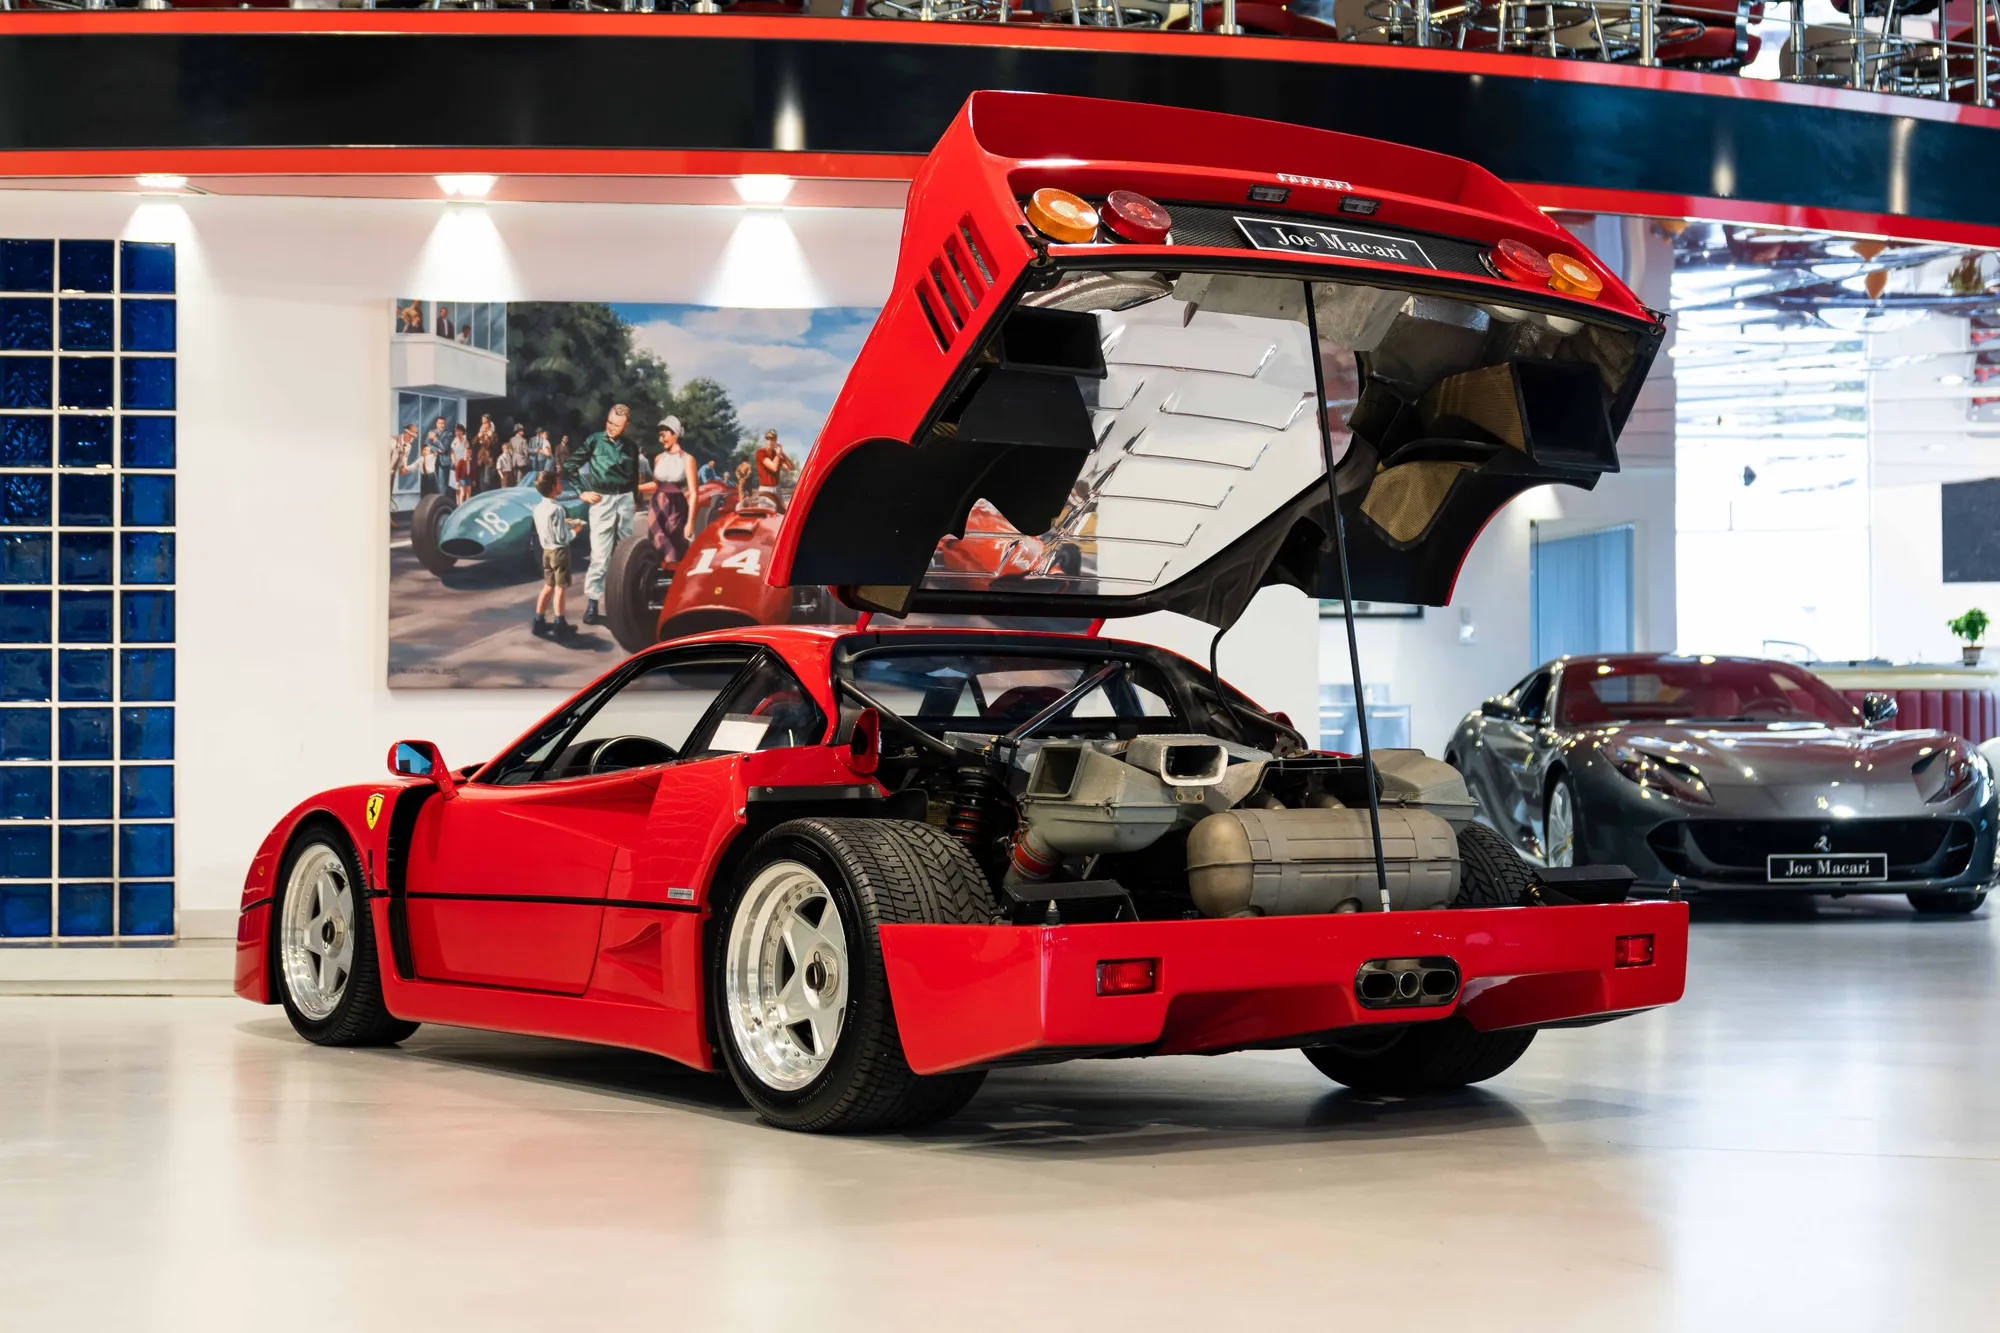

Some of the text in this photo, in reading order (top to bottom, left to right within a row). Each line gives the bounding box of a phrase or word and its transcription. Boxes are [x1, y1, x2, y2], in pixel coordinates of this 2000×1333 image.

[1273, 226, 1408, 261] Joe Macari
[474, 511, 510, 536] 18
[686, 548, 761, 577] 14
[1785, 859, 1870, 876] Joe Macari
